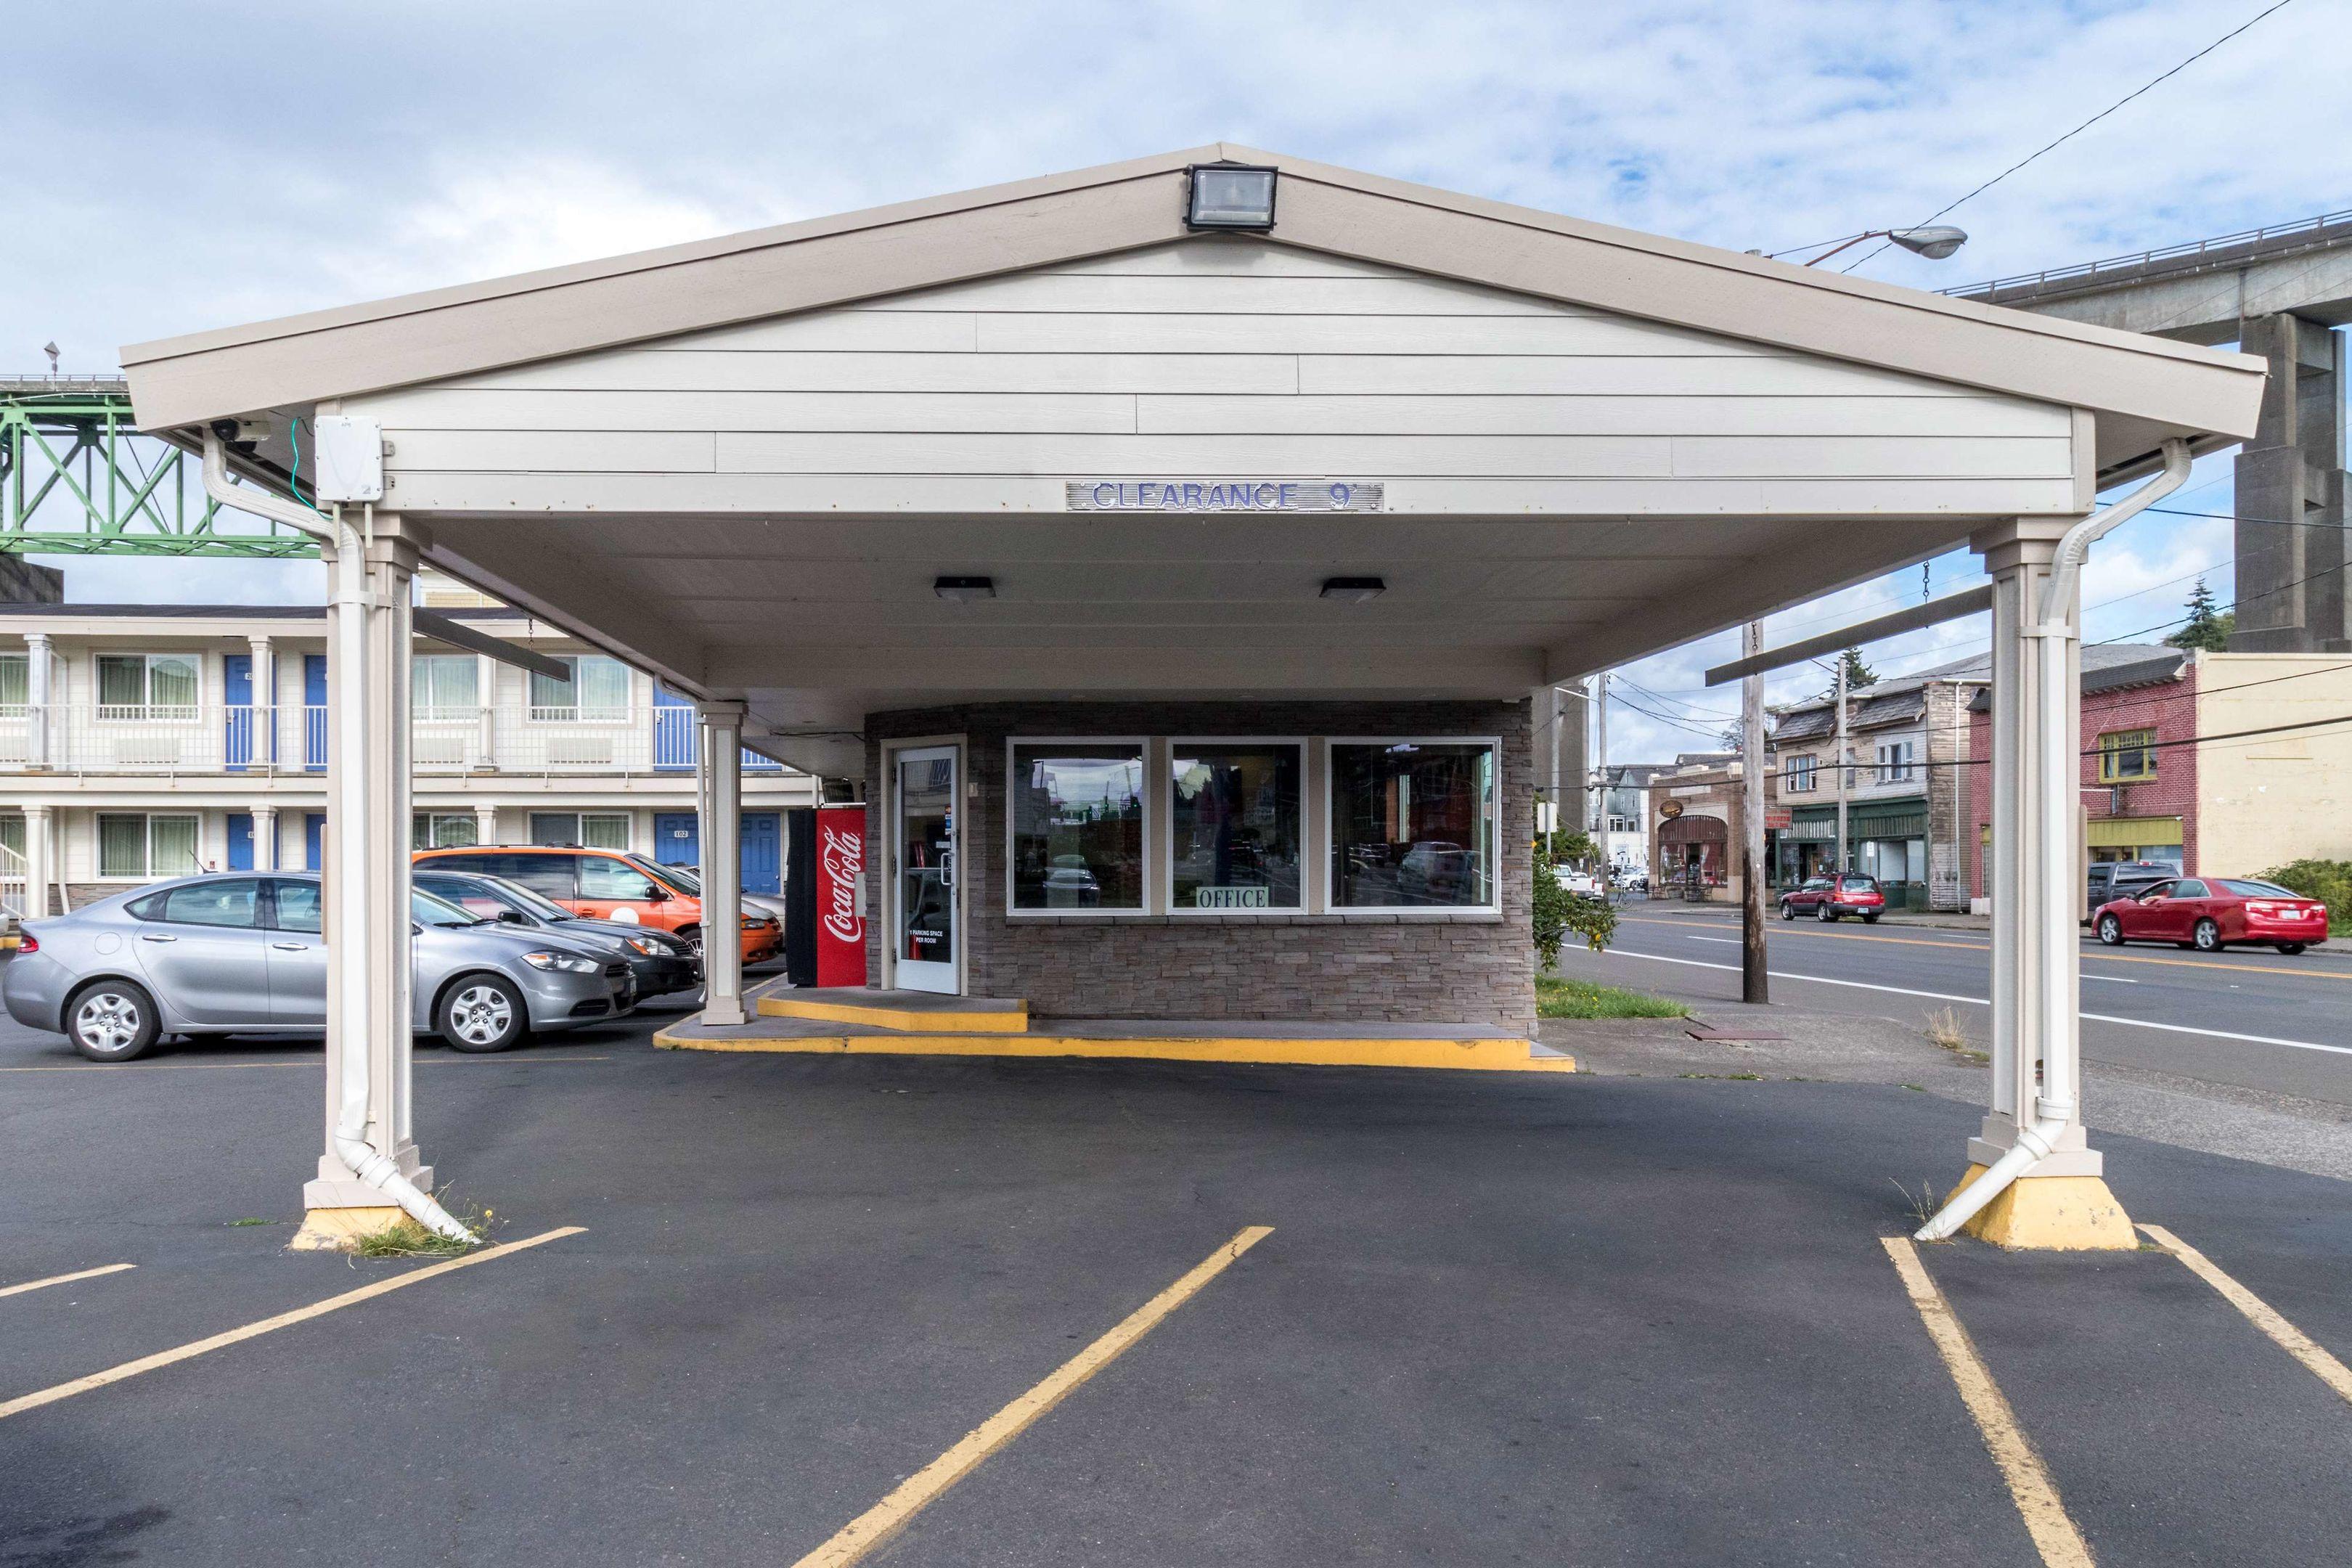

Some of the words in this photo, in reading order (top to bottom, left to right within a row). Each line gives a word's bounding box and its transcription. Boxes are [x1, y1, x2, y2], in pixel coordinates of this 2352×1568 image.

[1092, 482, 1298, 508] CLEARANCE
[824, 825, 862, 942] Coca-Cola
[1199, 889, 1266, 908] OFFICE
